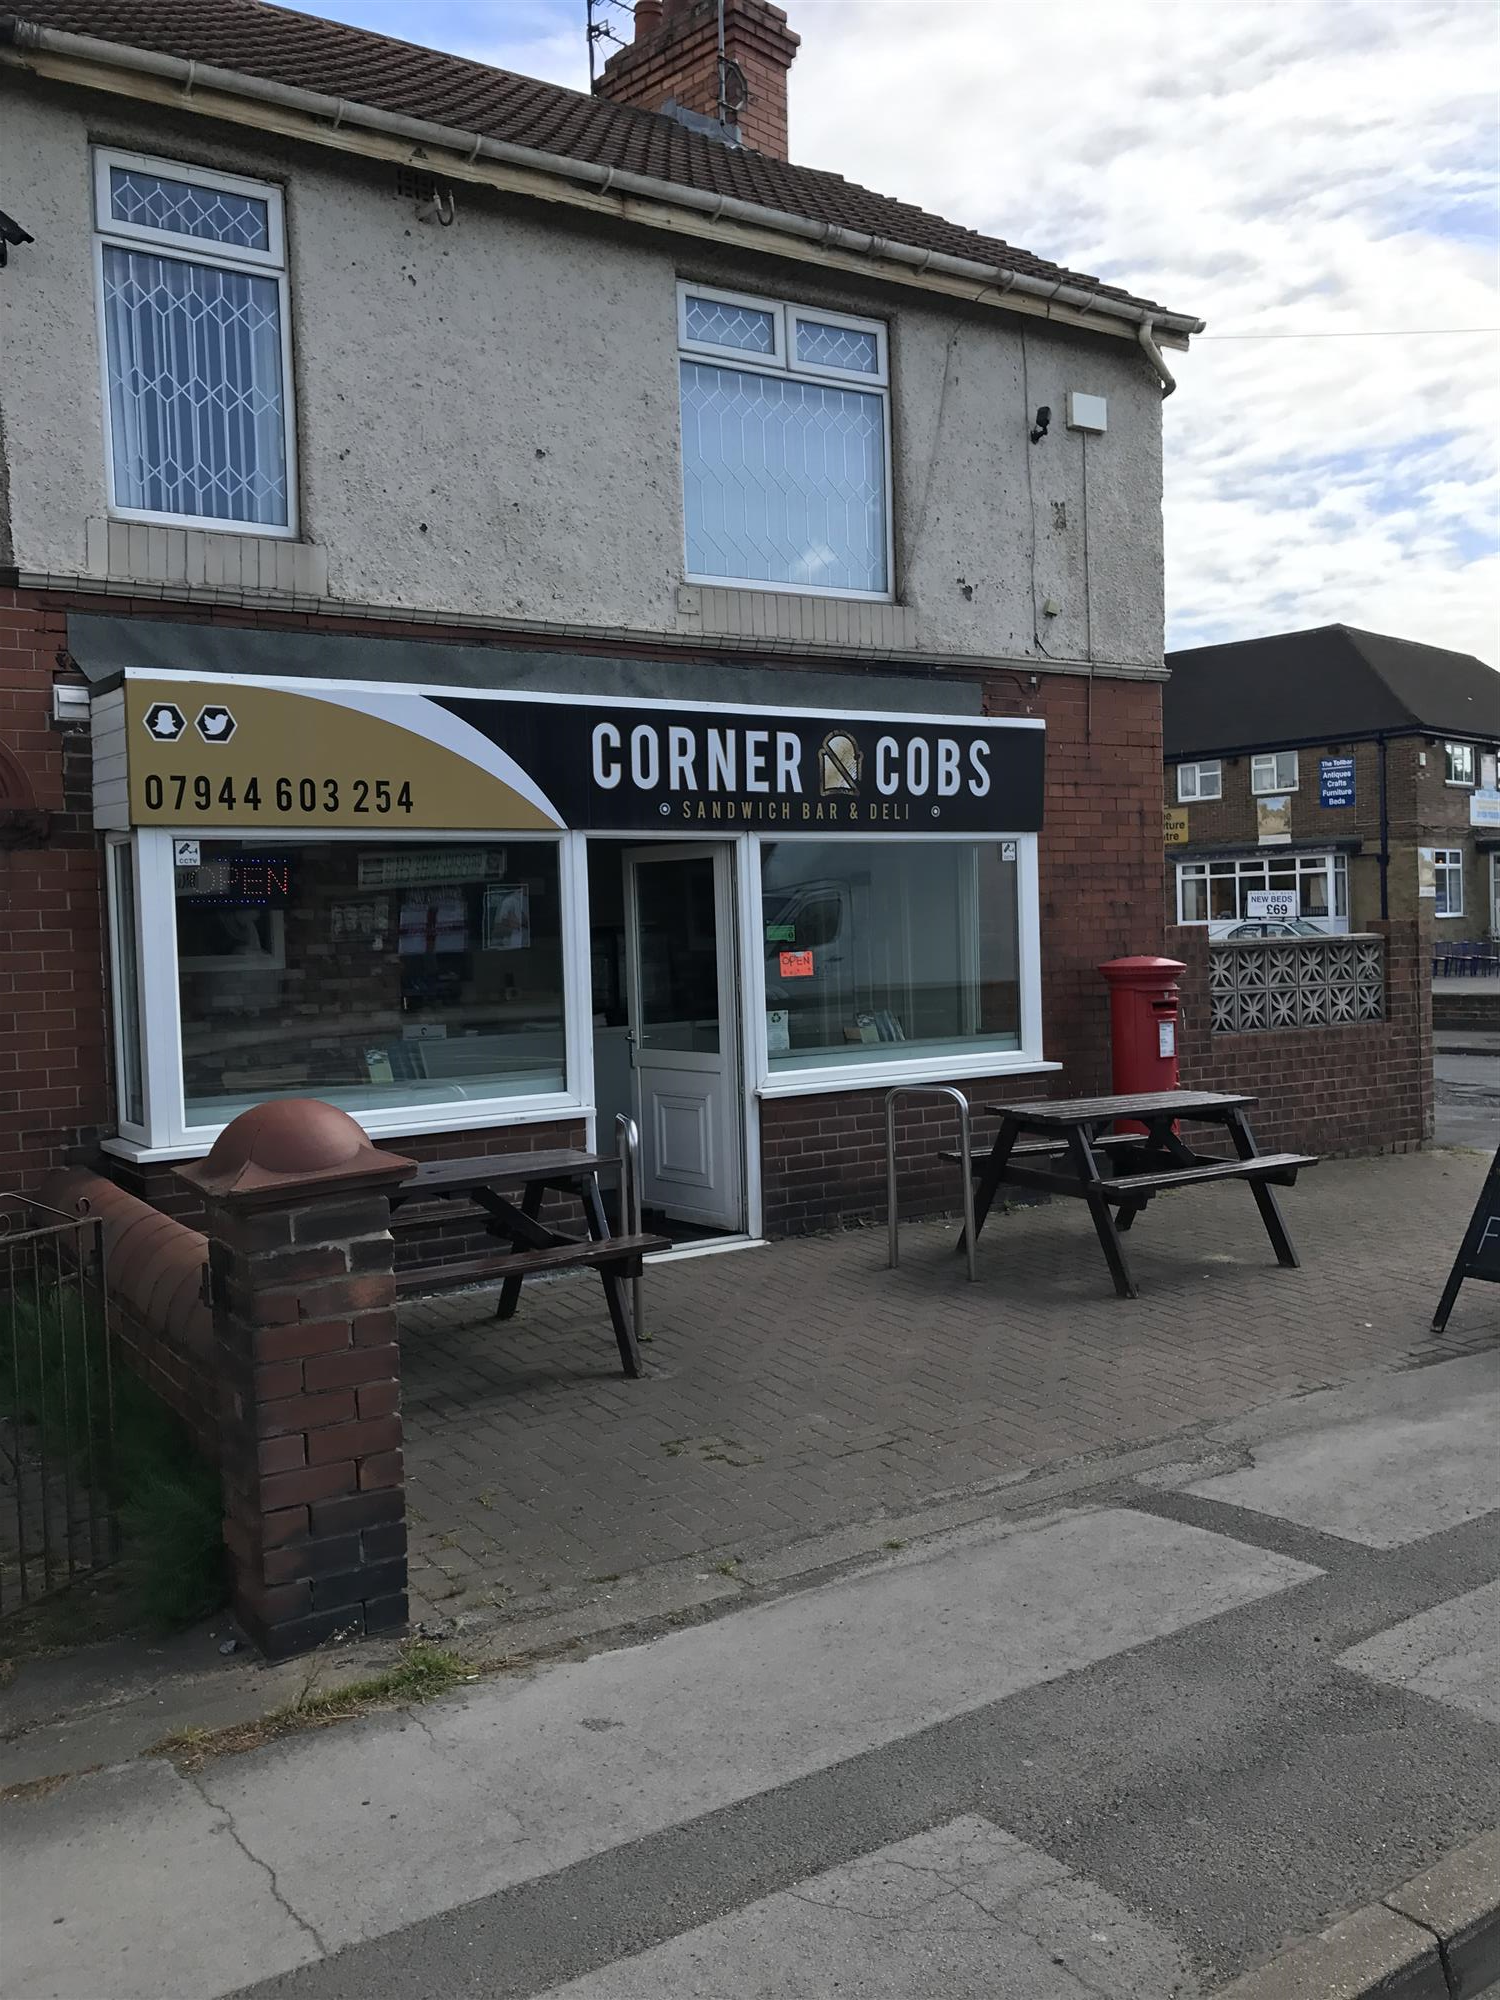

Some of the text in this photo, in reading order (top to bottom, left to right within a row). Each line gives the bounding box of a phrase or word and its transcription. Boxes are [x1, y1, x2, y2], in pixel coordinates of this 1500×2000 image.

[591, 721, 992, 798] CORNER COBS
[1322, 770, 1352, 779] Antiques
[1327, 779, 1347, 788] Crafts
[144, 773, 415, 814] 07944 603 254
[1322, 788, 1352, 797] Furniture
[1328, 797, 1346, 805] Beds
[682, 800, 910, 821] SANDWICH BAR & DELI
[190, 865, 288, 895] OPEN
[1251, 895, 1293, 903] NEW BEDS
[1266, 903, 1288, 915] £69
[782, 955, 810, 967] OPEN
